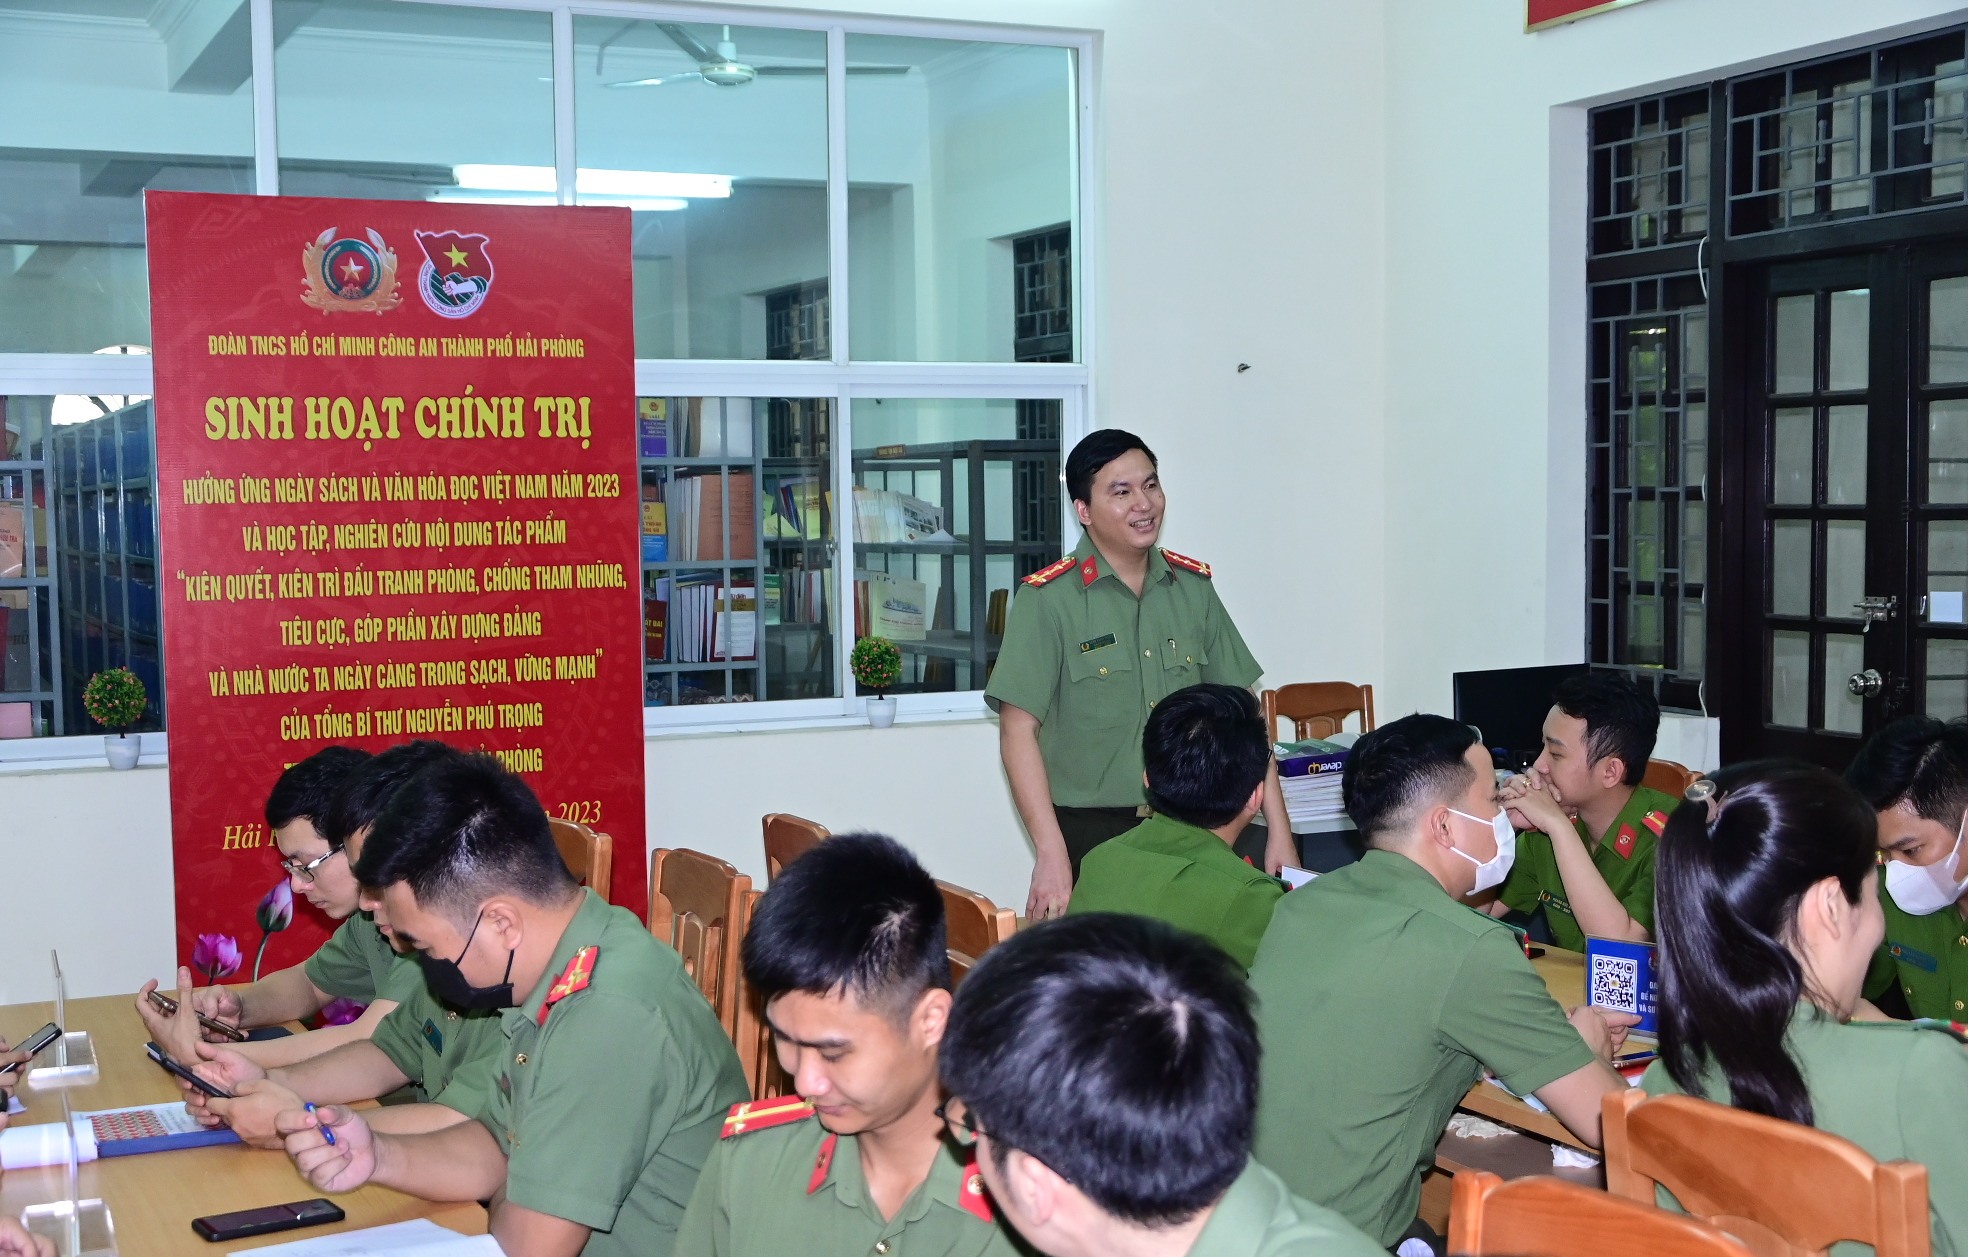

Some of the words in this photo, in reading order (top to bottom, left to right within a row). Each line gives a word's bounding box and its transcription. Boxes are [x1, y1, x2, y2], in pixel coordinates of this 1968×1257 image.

[208, 332, 248, 355] ĐOÀN
[251, 336, 287, 356] TNCS
[290, 330, 310, 356] HỒ
[313, 333, 336, 356] CHÍ
[339, 337, 376, 356] MINH
[379, 333, 416, 357] CÔNG
[419, 338, 438, 357] AN
[441, 335, 485, 357] THÀNH
[487, 332, 514, 357] PHỐ
[516, 332, 539, 357] HẢI
[541, 334, 585, 357] PHÒNG
[204, 397, 295, 440] SINH
[303, 397, 405, 451] HOẠT
[414, 384, 526, 439] CHÍNH
[533, 397, 592, 449] TRỊ
[183, 471, 237, 505] HƯỞNG
[240, 473, 272, 504] ỨNG
[275, 473, 315, 503] NGÀY
[319, 472, 359, 502] SÁCH
[362, 472, 382, 501] VÀ
[384, 472, 415, 501] VĂN
[418, 471, 448, 500] HÓA
[450, 475, 479, 505] ĐỌC
[482, 470, 512, 504] VIỆT
[515, 475, 548, 498] NAM
[552, 470, 584, 498] NĂM
[587, 474, 620, 497] 2023
[243, 522, 263, 552] VÀ
[266, 525, 297, 556] HỌC
[300, 520, 331, 555] TẬP,
[334, 519, 389, 549] NGHIÊN
[393, 518, 422, 548] CỨU
[425, 517, 450, 552] NỘI
[454, 521, 493, 546] DUNG
[496, 516, 523, 545] TÁC
[526, 510, 567, 544] PHẨM
[177, 570, 223, 601] “KIÊN
[226, 566, 275, 602] QUYẾT,
[279, 568, 314, 598] KIÊN
[317, 567, 341, 597] TRÌ
[344, 562, 374, 596] ĐẤU
[377, 570, 424, 595] TRANH
[428, 563, 480, 594] PHÒNG,
[484, 558, 531, 591] CHỐNG
[534, 565, 573, 589] THAM
[577, 560, 627, 589] NHŨNG,
[280, 615, 313, 645] TIÊU
[317, 617, 351, 649] CỰC,
[354, 613, 383, 643] GÓP
[387, 608, 427, 641] PHẦN
[431, 610, 458, 639] XÂY
[462, 612, 500, 643] DỰNG
[504, 605, 542, 636] ĐẢNG
[209, 666, 230, 696] VÀ
[233, 665, 265, 695] NHÀ
[269, 663, 310, 693] NƯỚC
[313, 667, 331, 691] TA
[334, 661, 373, 690] NGÀY
[377, 659, 416, 688] CÀNG
[420, 661, 466, 686] TRONG
[470, 659, 511, 688] SẠCH,
[515, 653, 552, 681] VỮNG
[556, 648, 603, 684] MẠNH”
[281, 707, 311, 740] CỦA
[314, 704, 353, 738] TỔNG
[357, 707, 372, 736] BÍ
[375, 708, 404, 735] THƯ
[406, 699, 463, 733] NGUYỄN
[467, 700, 495, 730] PHÚ
[498, 703, 543, 732] TRỌNG
[558, 800, 602, 824] 2023
[222, 823, 262, 850] Hải
